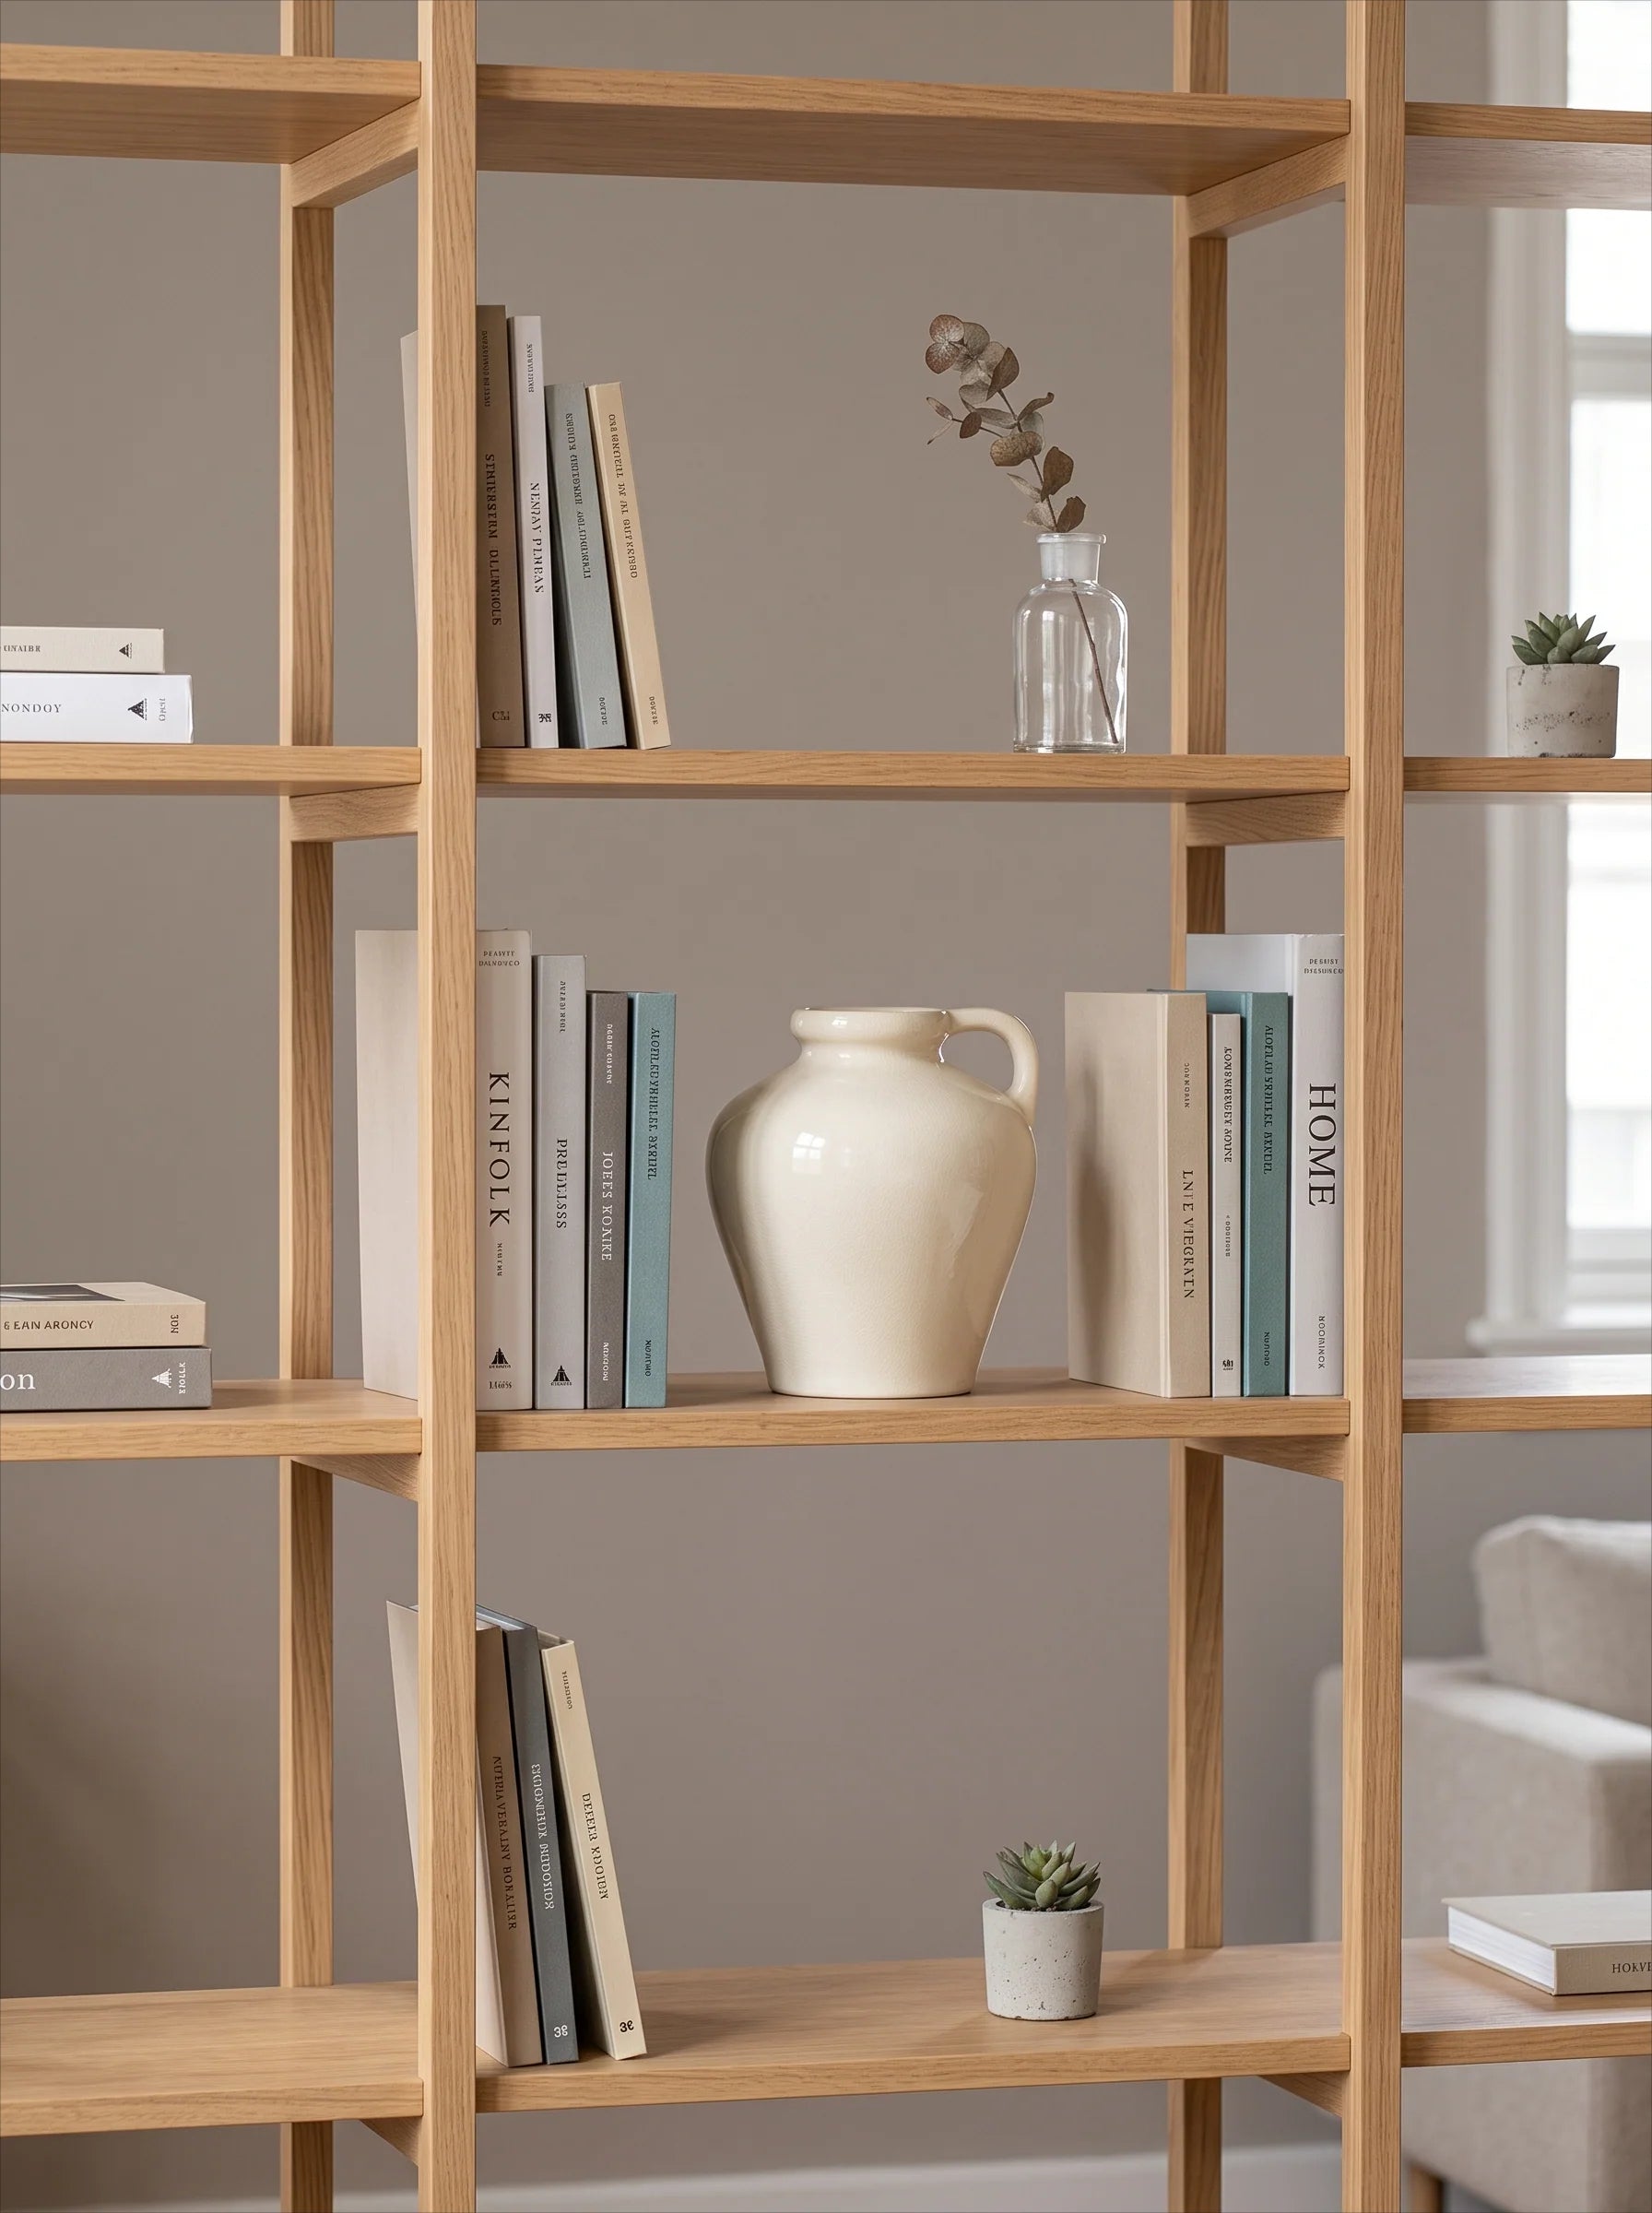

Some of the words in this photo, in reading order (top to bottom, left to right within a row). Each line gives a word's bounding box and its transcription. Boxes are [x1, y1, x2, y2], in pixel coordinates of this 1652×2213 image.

[488, 1071, 511, 1228] KINFOLK
[1308, 1083, 1337, 1208] HOME
[44, 1320, 94, 1330] ARONCY
